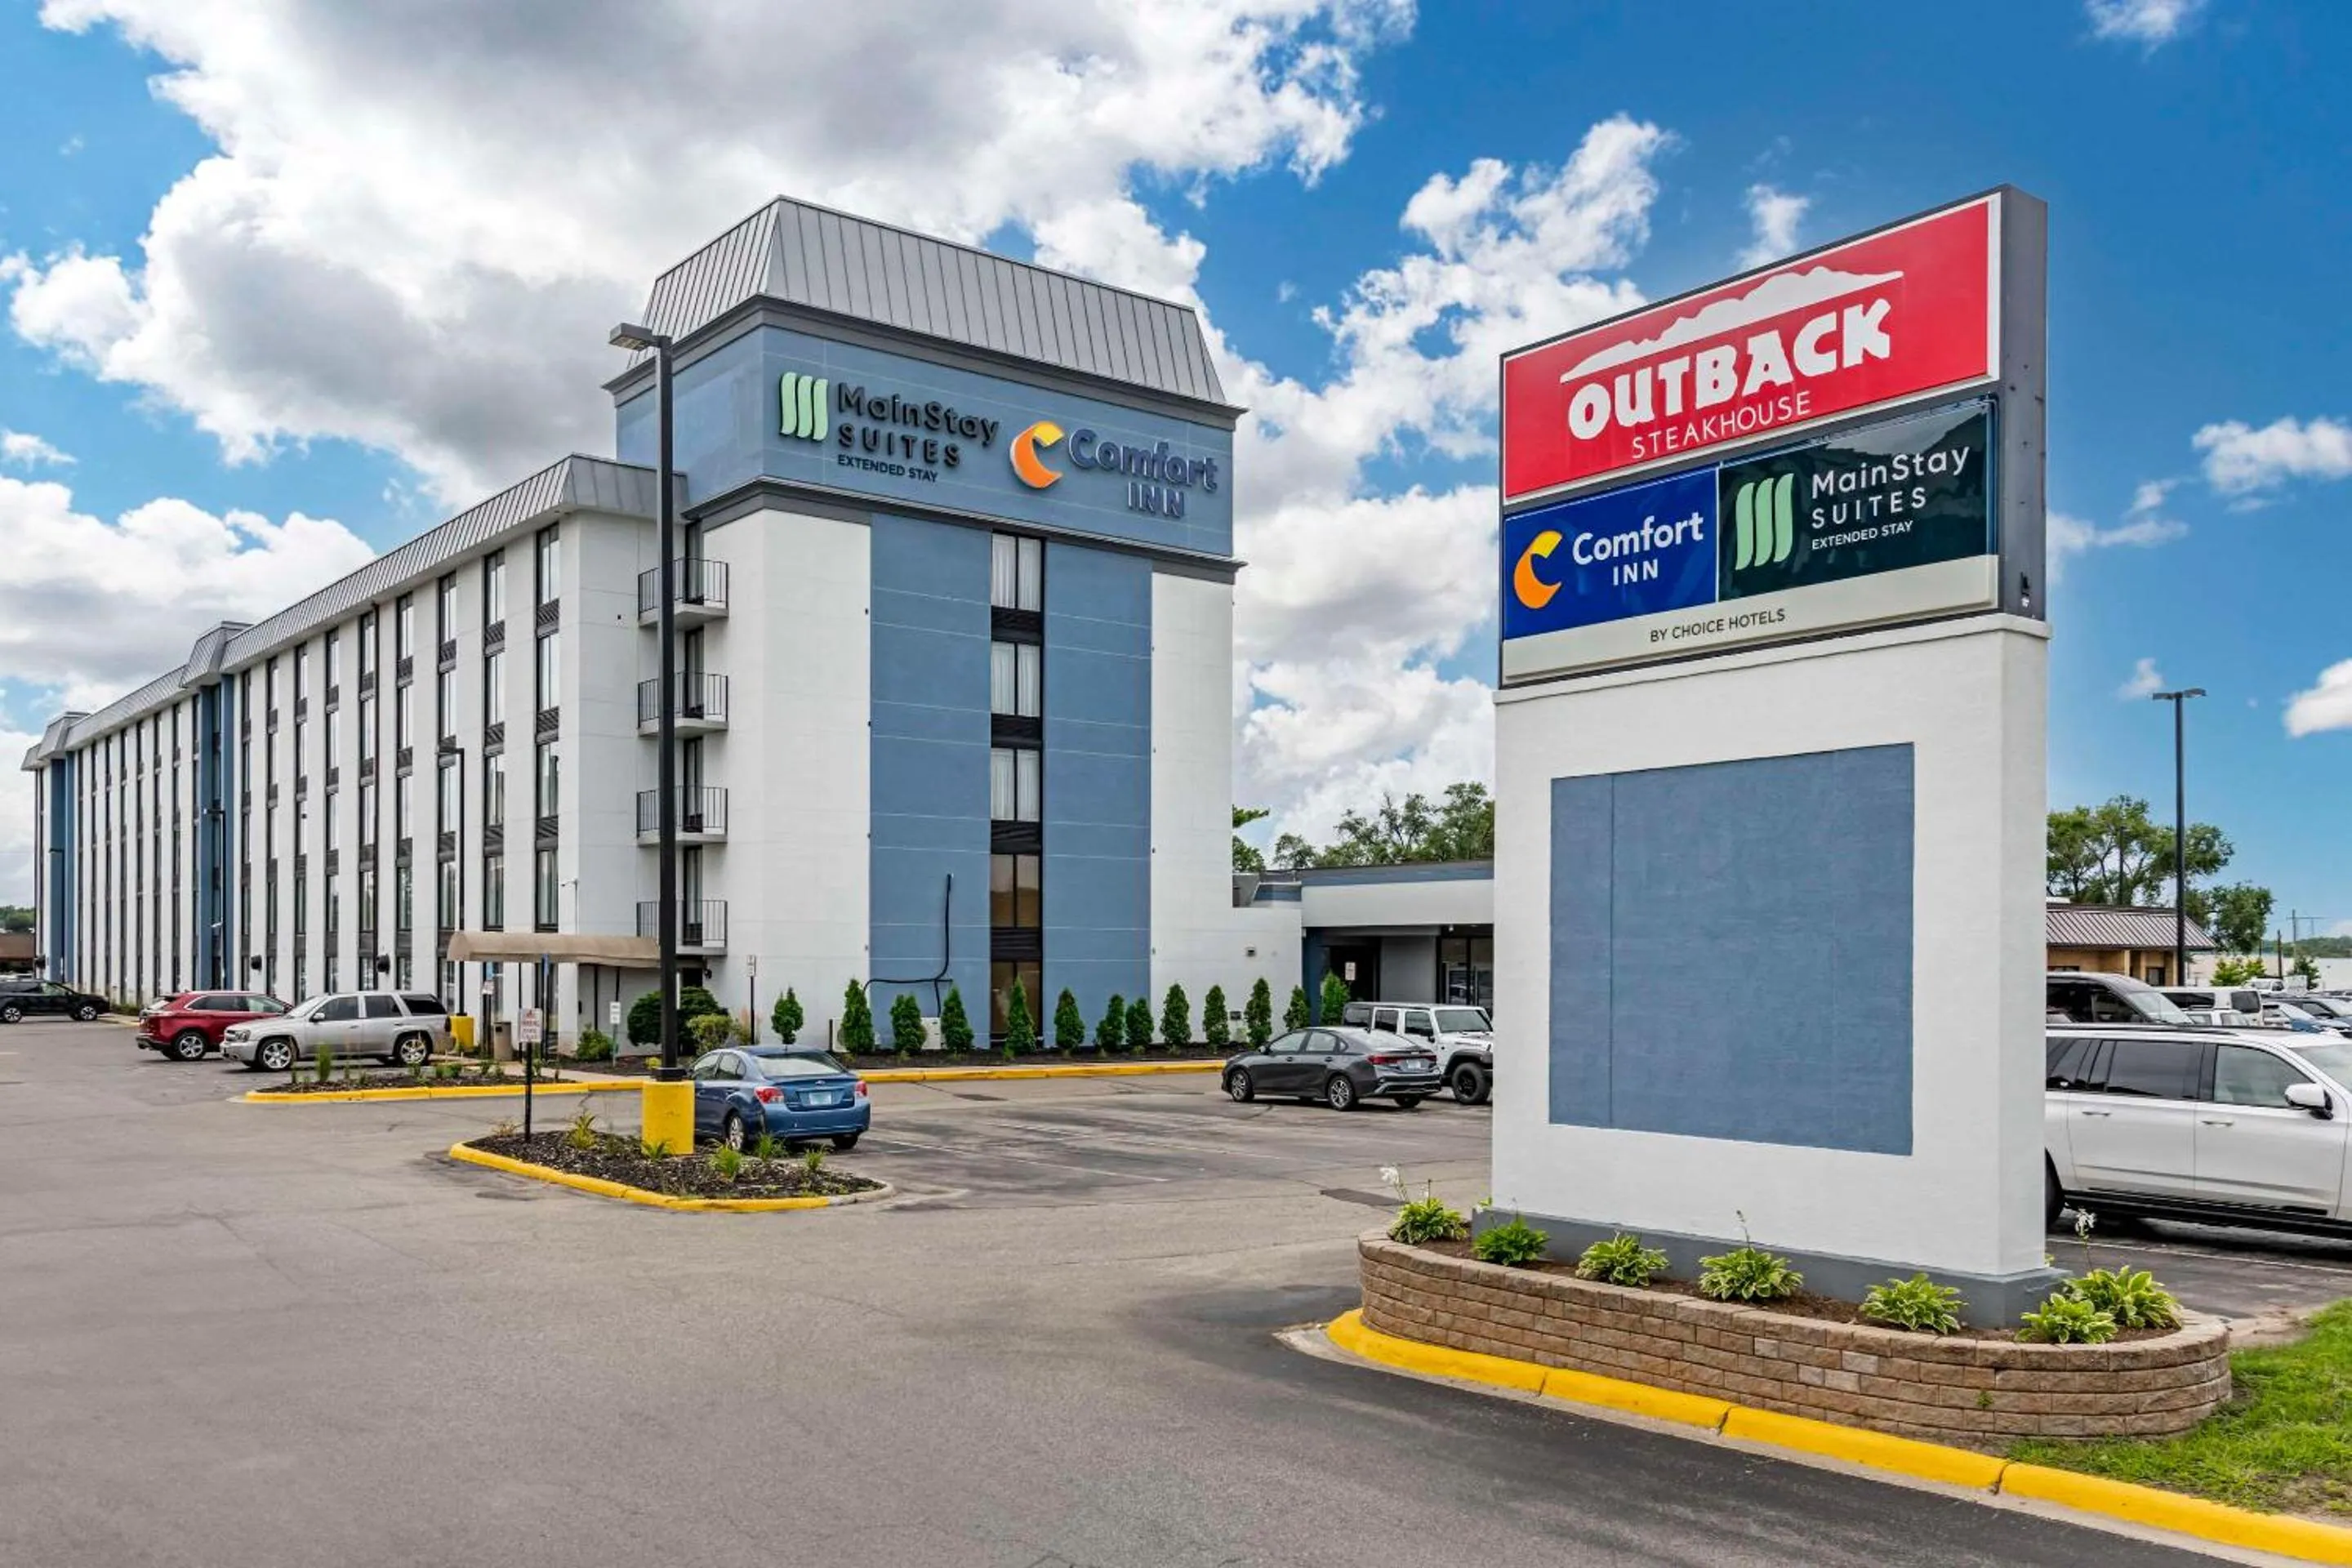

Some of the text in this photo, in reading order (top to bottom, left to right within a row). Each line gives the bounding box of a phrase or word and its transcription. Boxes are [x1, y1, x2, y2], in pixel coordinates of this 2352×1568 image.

[1568, 298, 1891, 440] OUTBACK
[838, 381, 999, 447] MainStay
[1632, 390, 1811, 459] STEAKHOUSE
[838, 422, 960, 467] SUITES
[1069, 428, 1218, 492] Comfort
[838, 454, 938, 483] EXTENDED STAY
[1811, 446, 1970, 500] MainStay
[1128, 481, 1185, 518] INN
[1811, 487, 1927, 529] SUITES
[1572, 511, 1704, 565] Comfort
[1811, 520, 1913, 550] EXTENDED STAY
[1613, 559, 1659, 586] INN
[1650, 608, 1786, 642] BY CHOICE HOTELS
